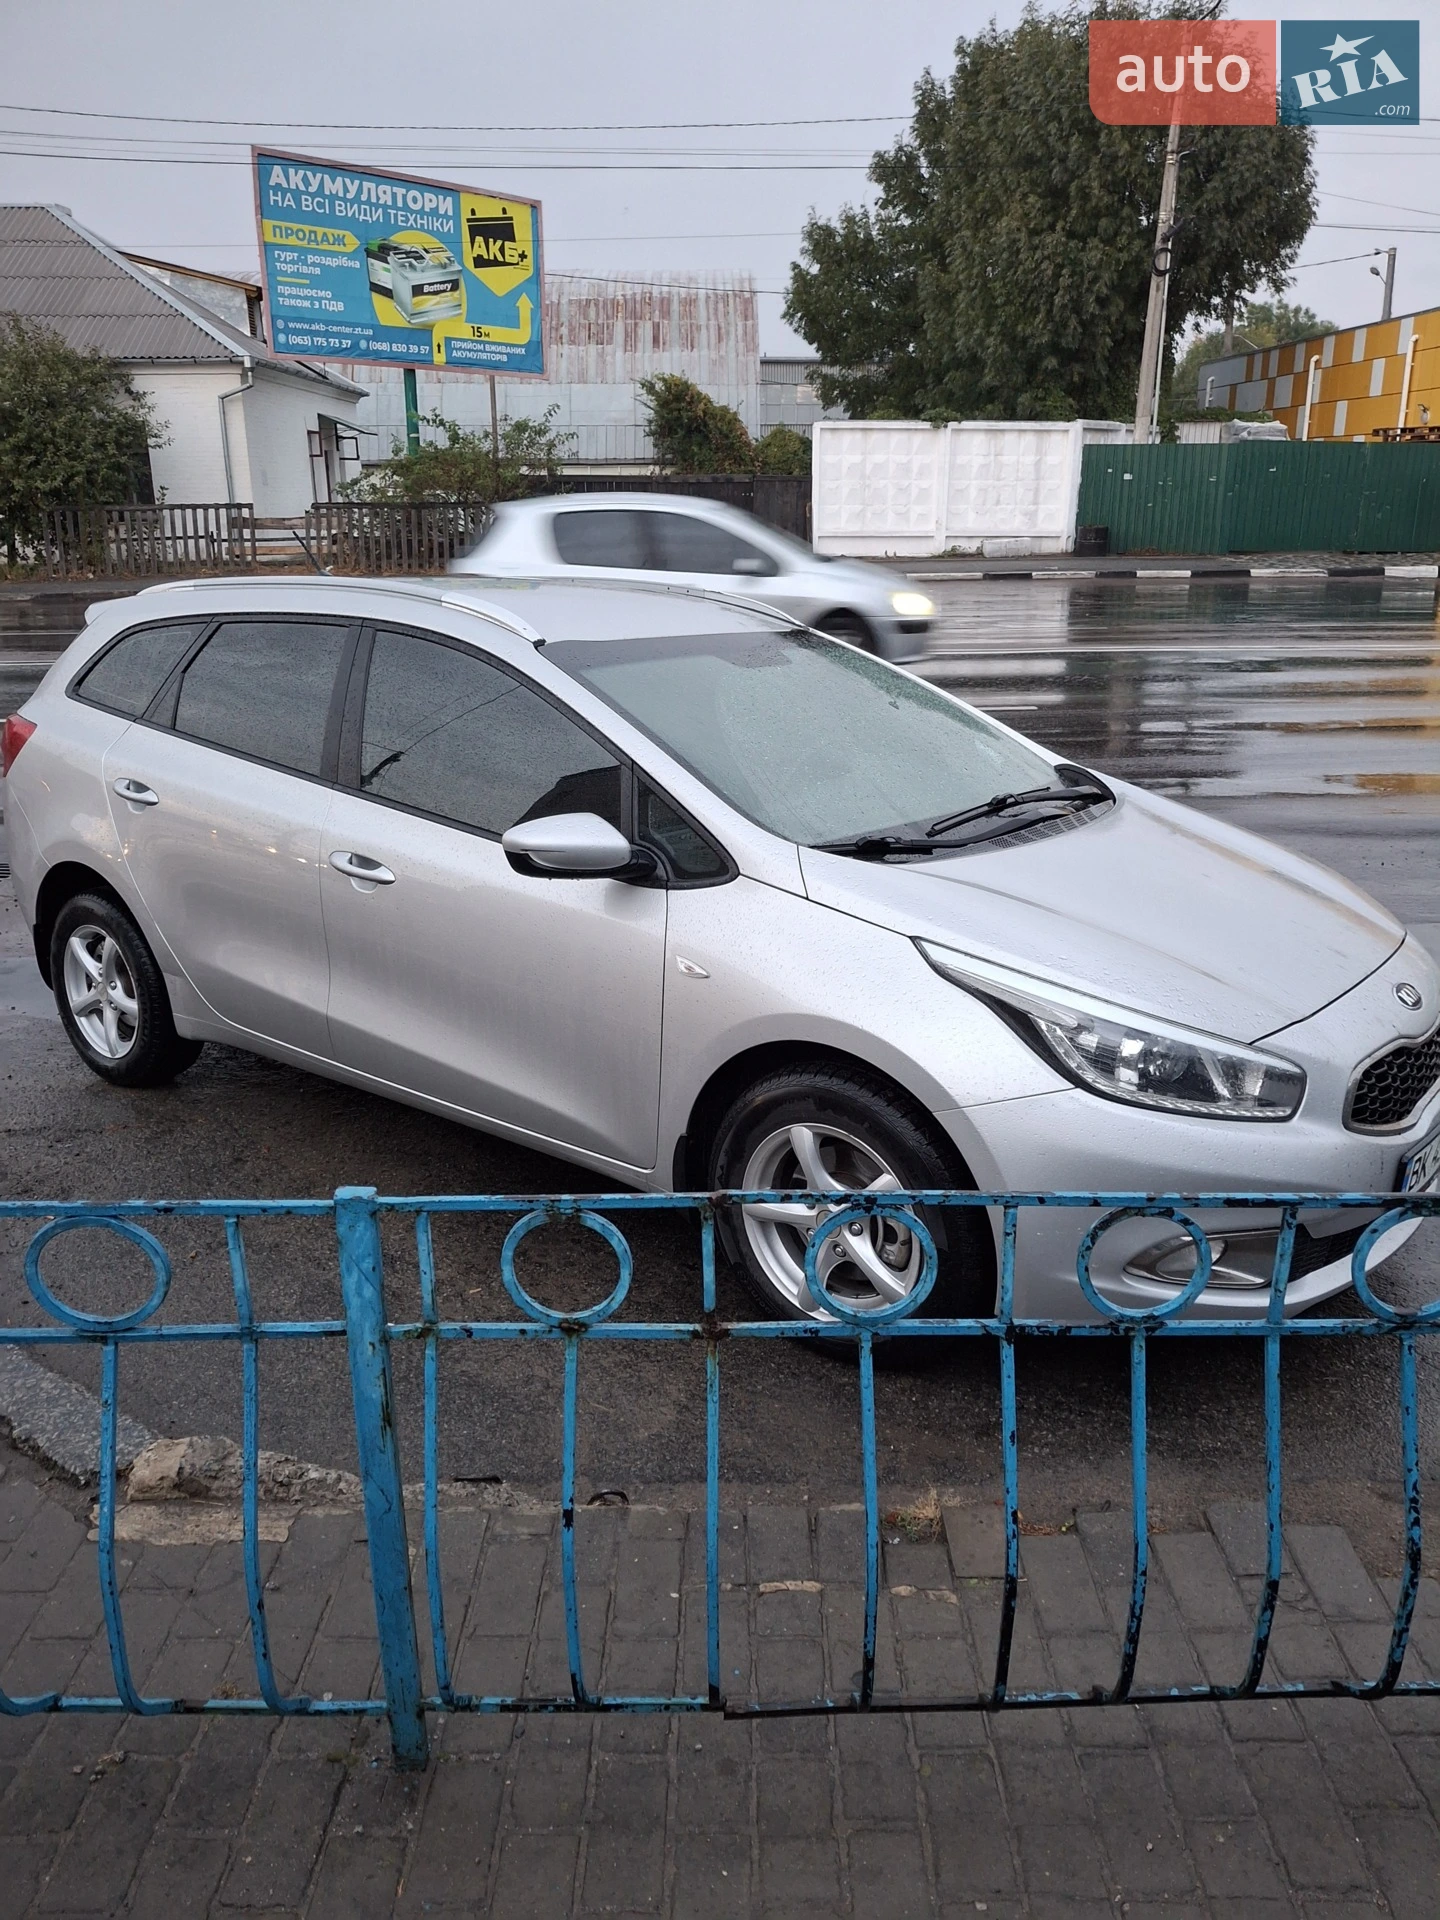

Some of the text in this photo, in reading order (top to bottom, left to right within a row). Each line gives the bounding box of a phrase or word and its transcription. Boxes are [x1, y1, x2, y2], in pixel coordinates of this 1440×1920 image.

[268, 165, 453, 216] АКУМУЛЯТОРИ
[269, 190, 454, 234] НА ВСІ ВИДИ ТЕХНІКИ
[272, 225, 347, 247] ПРОДАЖ
[274, 250, 299, 262] гурт
[307, 254, 360, 268] роздрібна
[275, 262, 321, 275] торгівля
[277, 285, 332, 298] працюємо
[423, 282, 452, 293] Battery
[278, 297, 345, 312] також з ПДВ
[288, 333, 312, 347] (063)
[328, 338, 340, 348] 73
[340, 339, 352, 349] 37
[369, 340, 430, 355] (068) 830 39 57
[451, 341, 526, 355] ПРИЙОМ ВЖИВАНИХ
[451, 349, 508, 362] АКУМУЛЯТОРІВ
